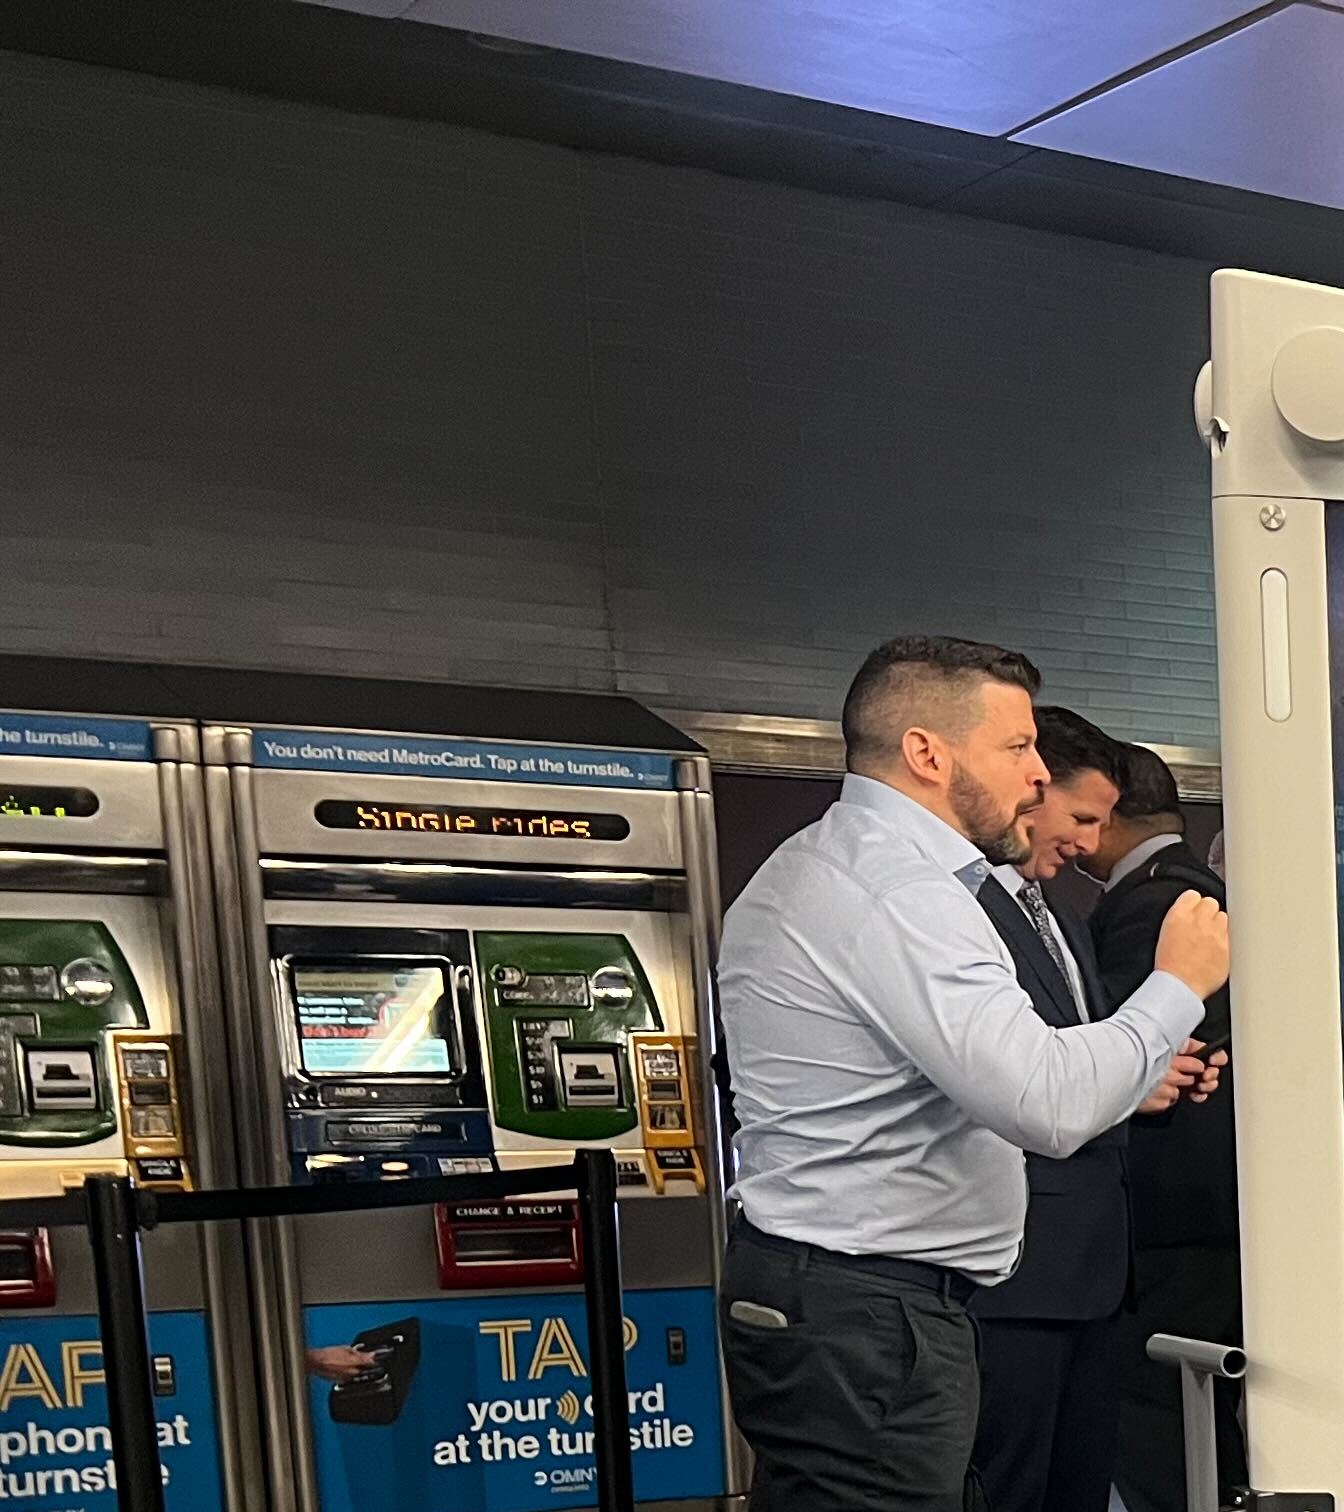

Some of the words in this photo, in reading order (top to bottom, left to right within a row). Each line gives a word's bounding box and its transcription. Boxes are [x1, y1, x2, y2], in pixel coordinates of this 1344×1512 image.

[25, 730, 104, 747] turnstile.
[263, 741, 297, 758] You
[300, 744, 344, 760] don't
[347, 749, 389, 764] need
[393, 749, 485, 769] MetroCard.
[487, 755, 518, 773] Tap
[521, 759, 536, 772] at
[539, 759, 564, 773] the
[568, 760, 635, 778] turnstile.
[456, 1207, 499, 1216] CHANGE
[520, 1206, 562, 1215] RECEIPT
[467, 1397, 550, 1432] your
[0, 1422, 113, 1465] phon
[157, 1414, 191, 1447] at
[434, 1433, 470, 1465] at
[478, 1431, 540, 1462] the
[548, 1418, 694, 1456] turstile
